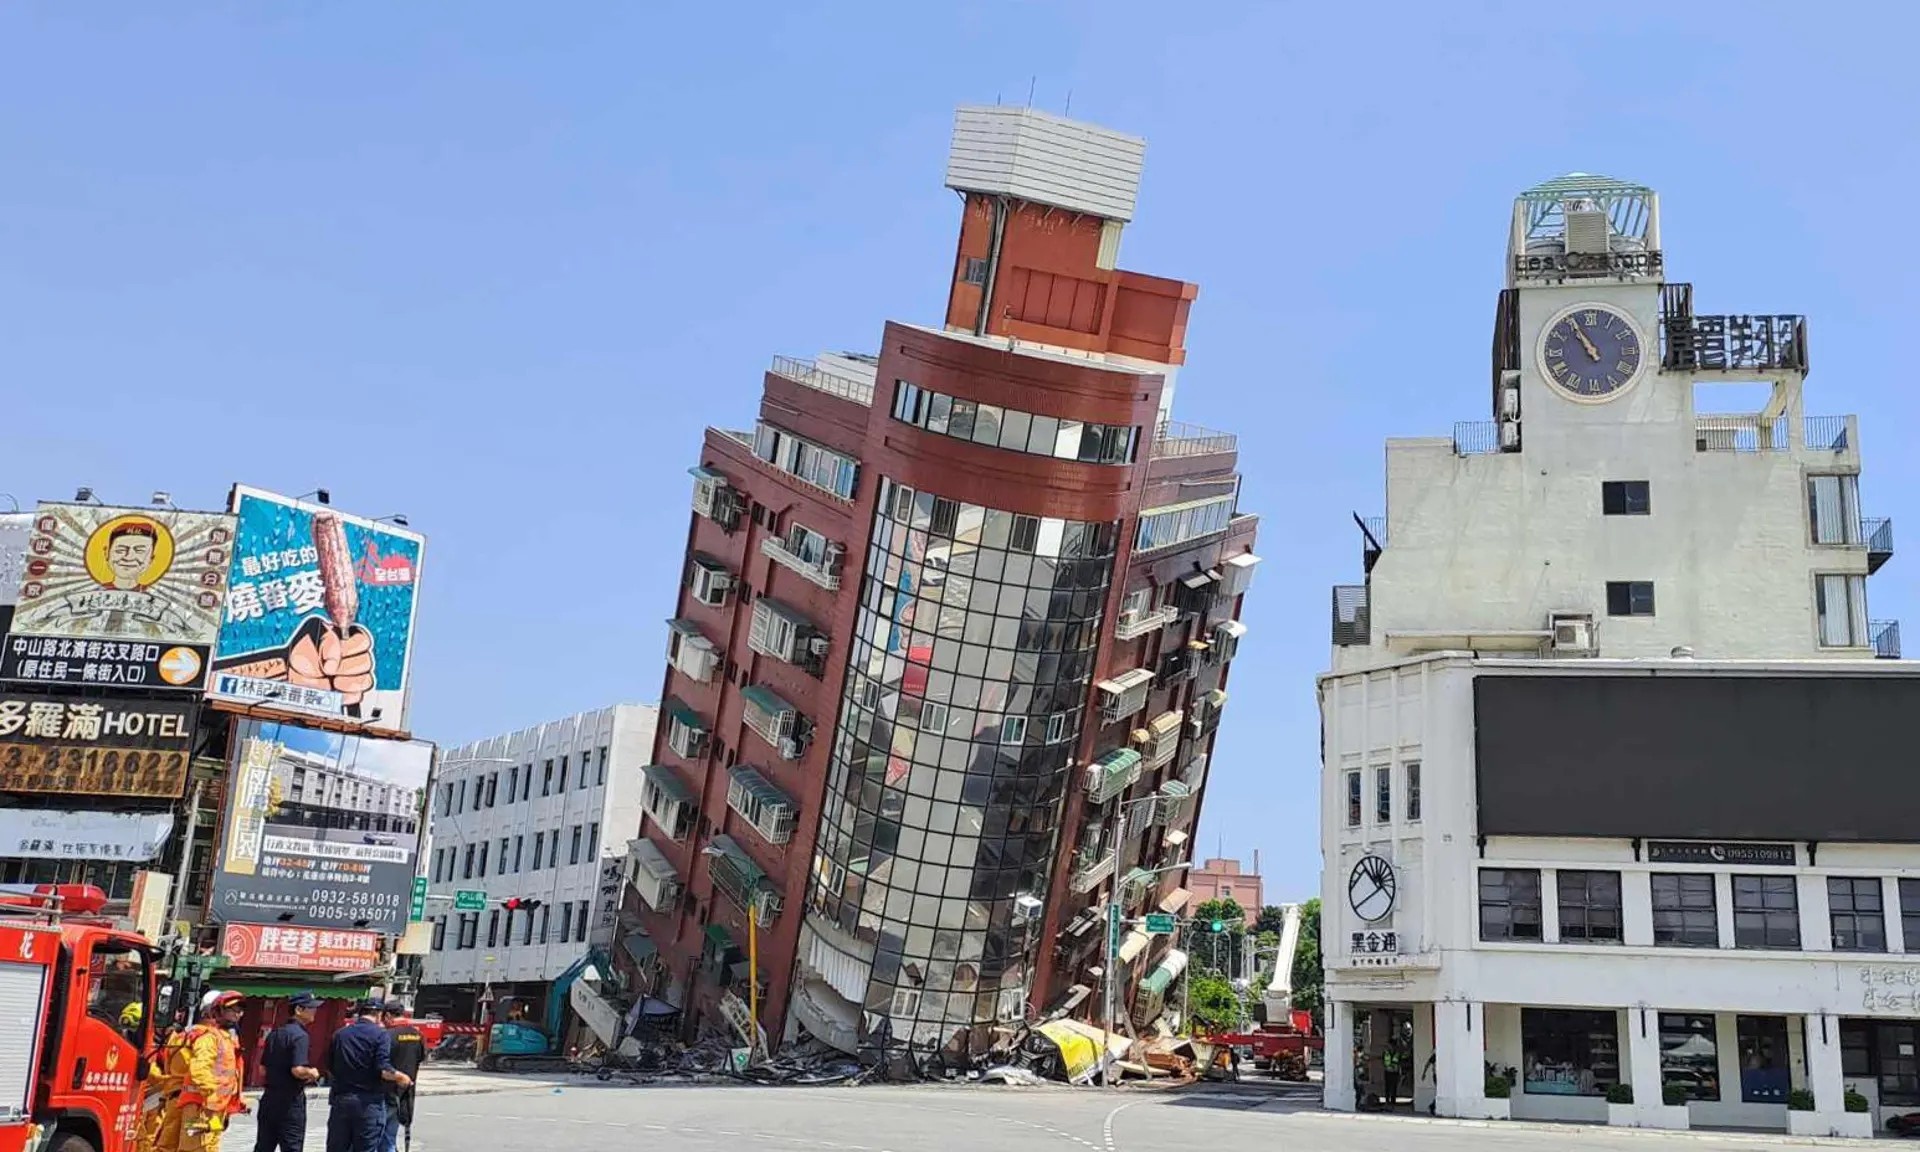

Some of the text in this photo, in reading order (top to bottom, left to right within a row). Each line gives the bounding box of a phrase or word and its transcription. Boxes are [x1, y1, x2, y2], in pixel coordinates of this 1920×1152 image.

[242, 546, 319, 578] 最好吃的
[13, 638, 160, 662] 中山路北濱街交叉路口
[16, 659, 147, 683] (原住民一條街入口)
[0, 701, 190, 740] 多羅滿 HOTEL
[312, 889, 400, 906] 0932-581018
[309, 905, 397, 922] 0905-935071
[19, 932, 34, 960] 花
[259, 927, 317, 954] 胖老爹
